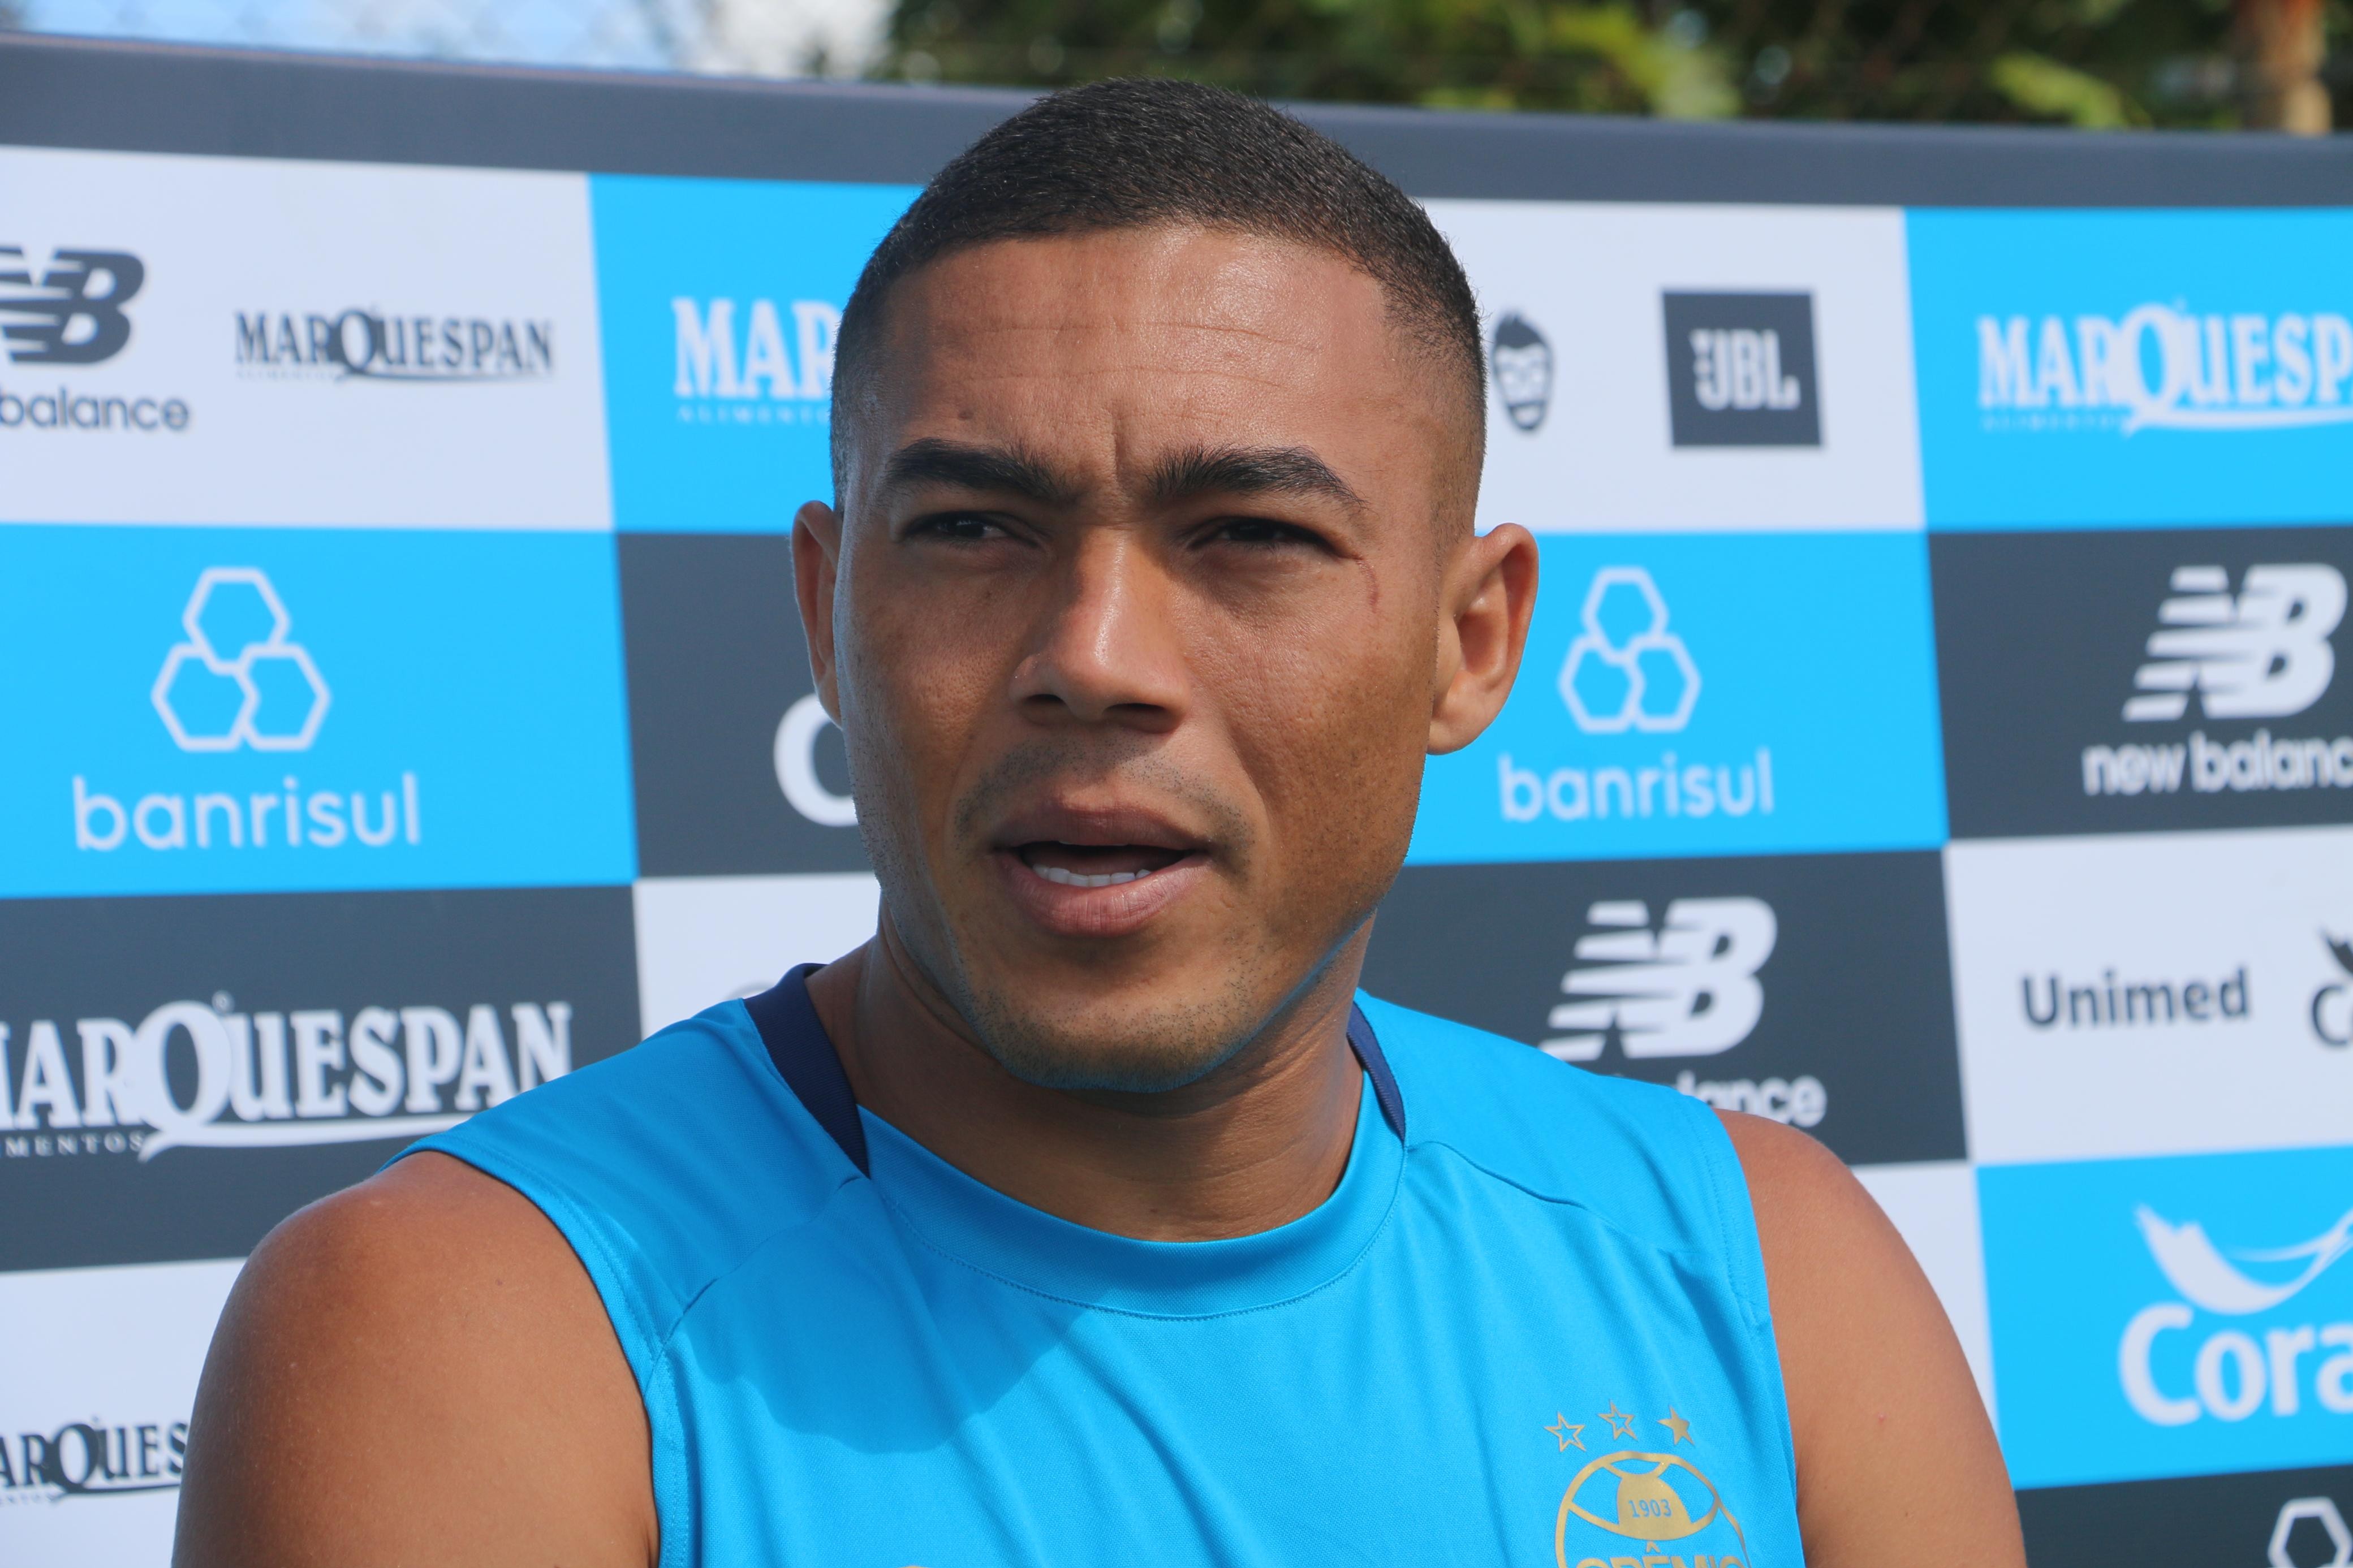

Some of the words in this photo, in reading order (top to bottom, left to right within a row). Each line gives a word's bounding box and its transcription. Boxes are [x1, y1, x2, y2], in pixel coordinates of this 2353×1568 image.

[234, 308, 553, 381] MARQUESPAN
[1689, 330, 1801, 411] JBL
[1977, 301, 2353, 435] MARQUESP
[1497, 746, 1774, 822] banrisul
[2082, 745, 2186, 794] new
[74, 772, 420, 850] banrisul
[2022, 965, 2250, 1028] Unimed
[1628, 1498, 1672, 1518] 1903
